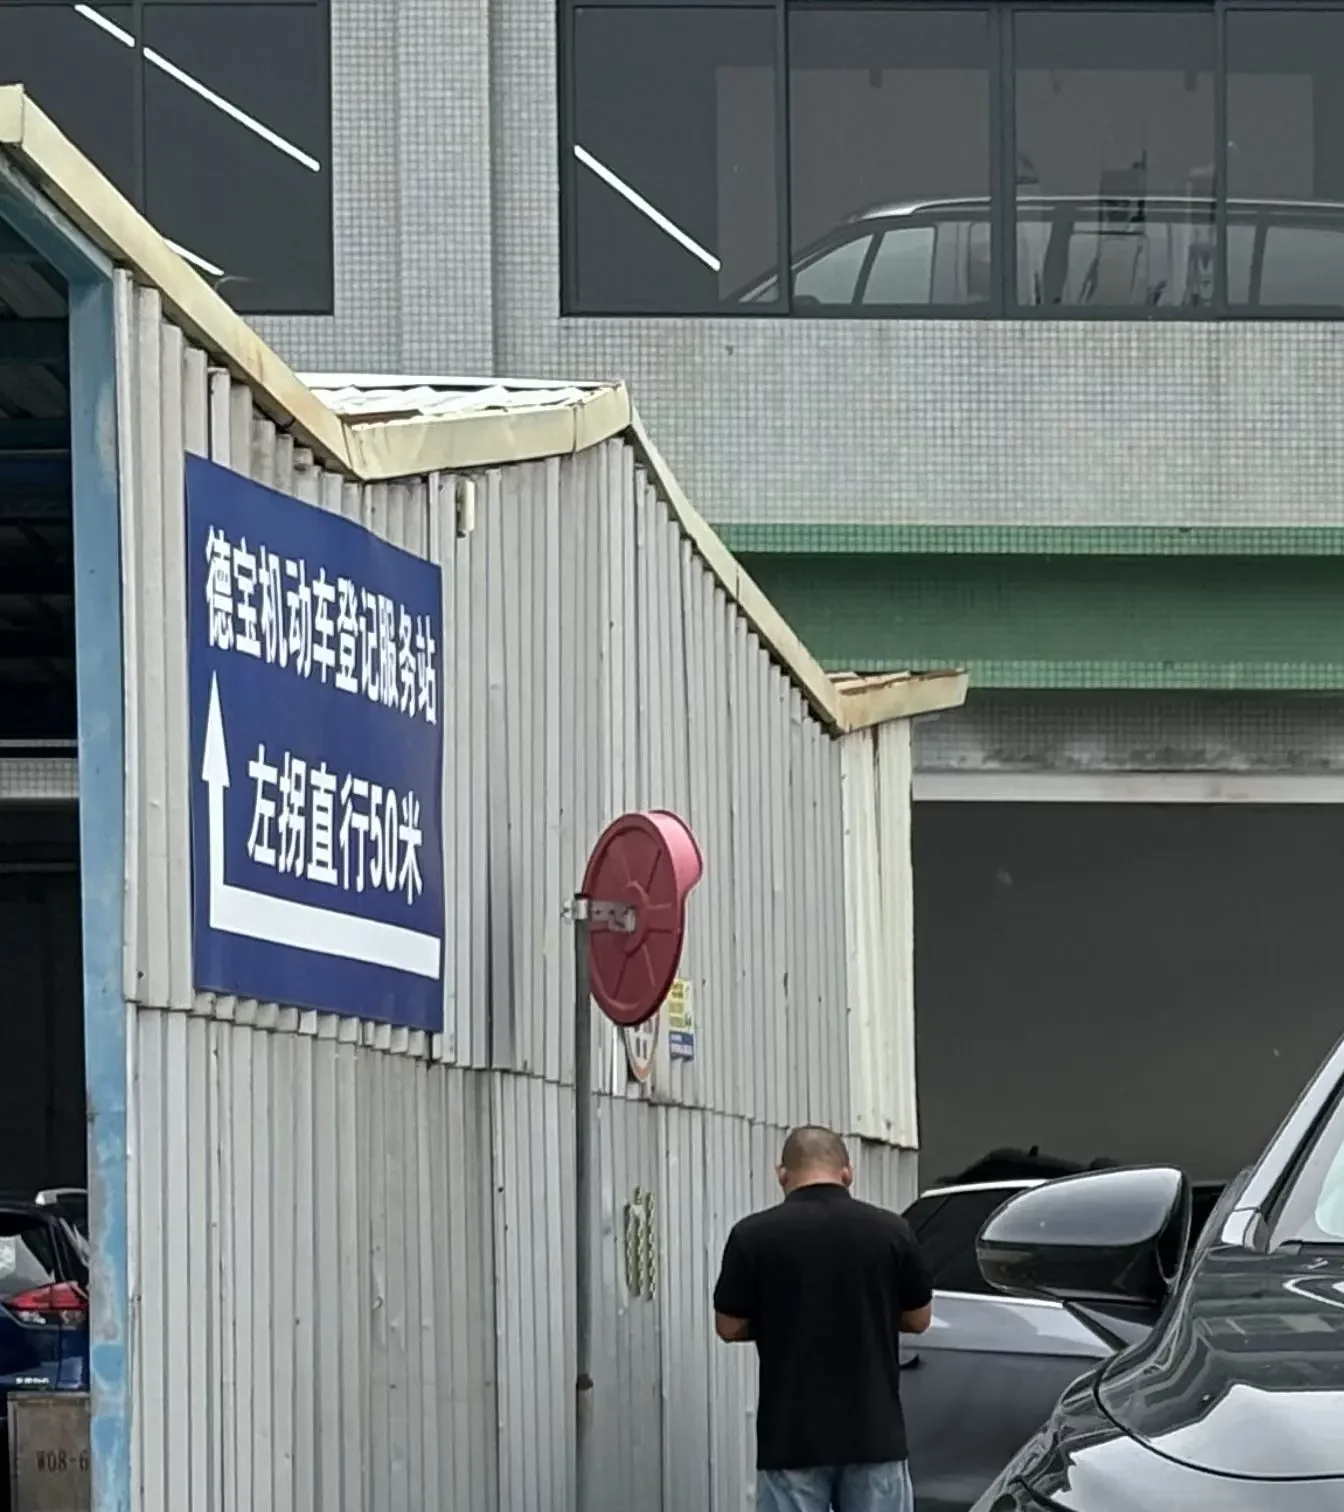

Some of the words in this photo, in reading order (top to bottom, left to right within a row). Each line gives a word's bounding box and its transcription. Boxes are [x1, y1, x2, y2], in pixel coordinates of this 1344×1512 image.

[206, 525, 437, 725] 德宝机动车登记服务站
[247, 743, 423, 906] 左拐直行50米
